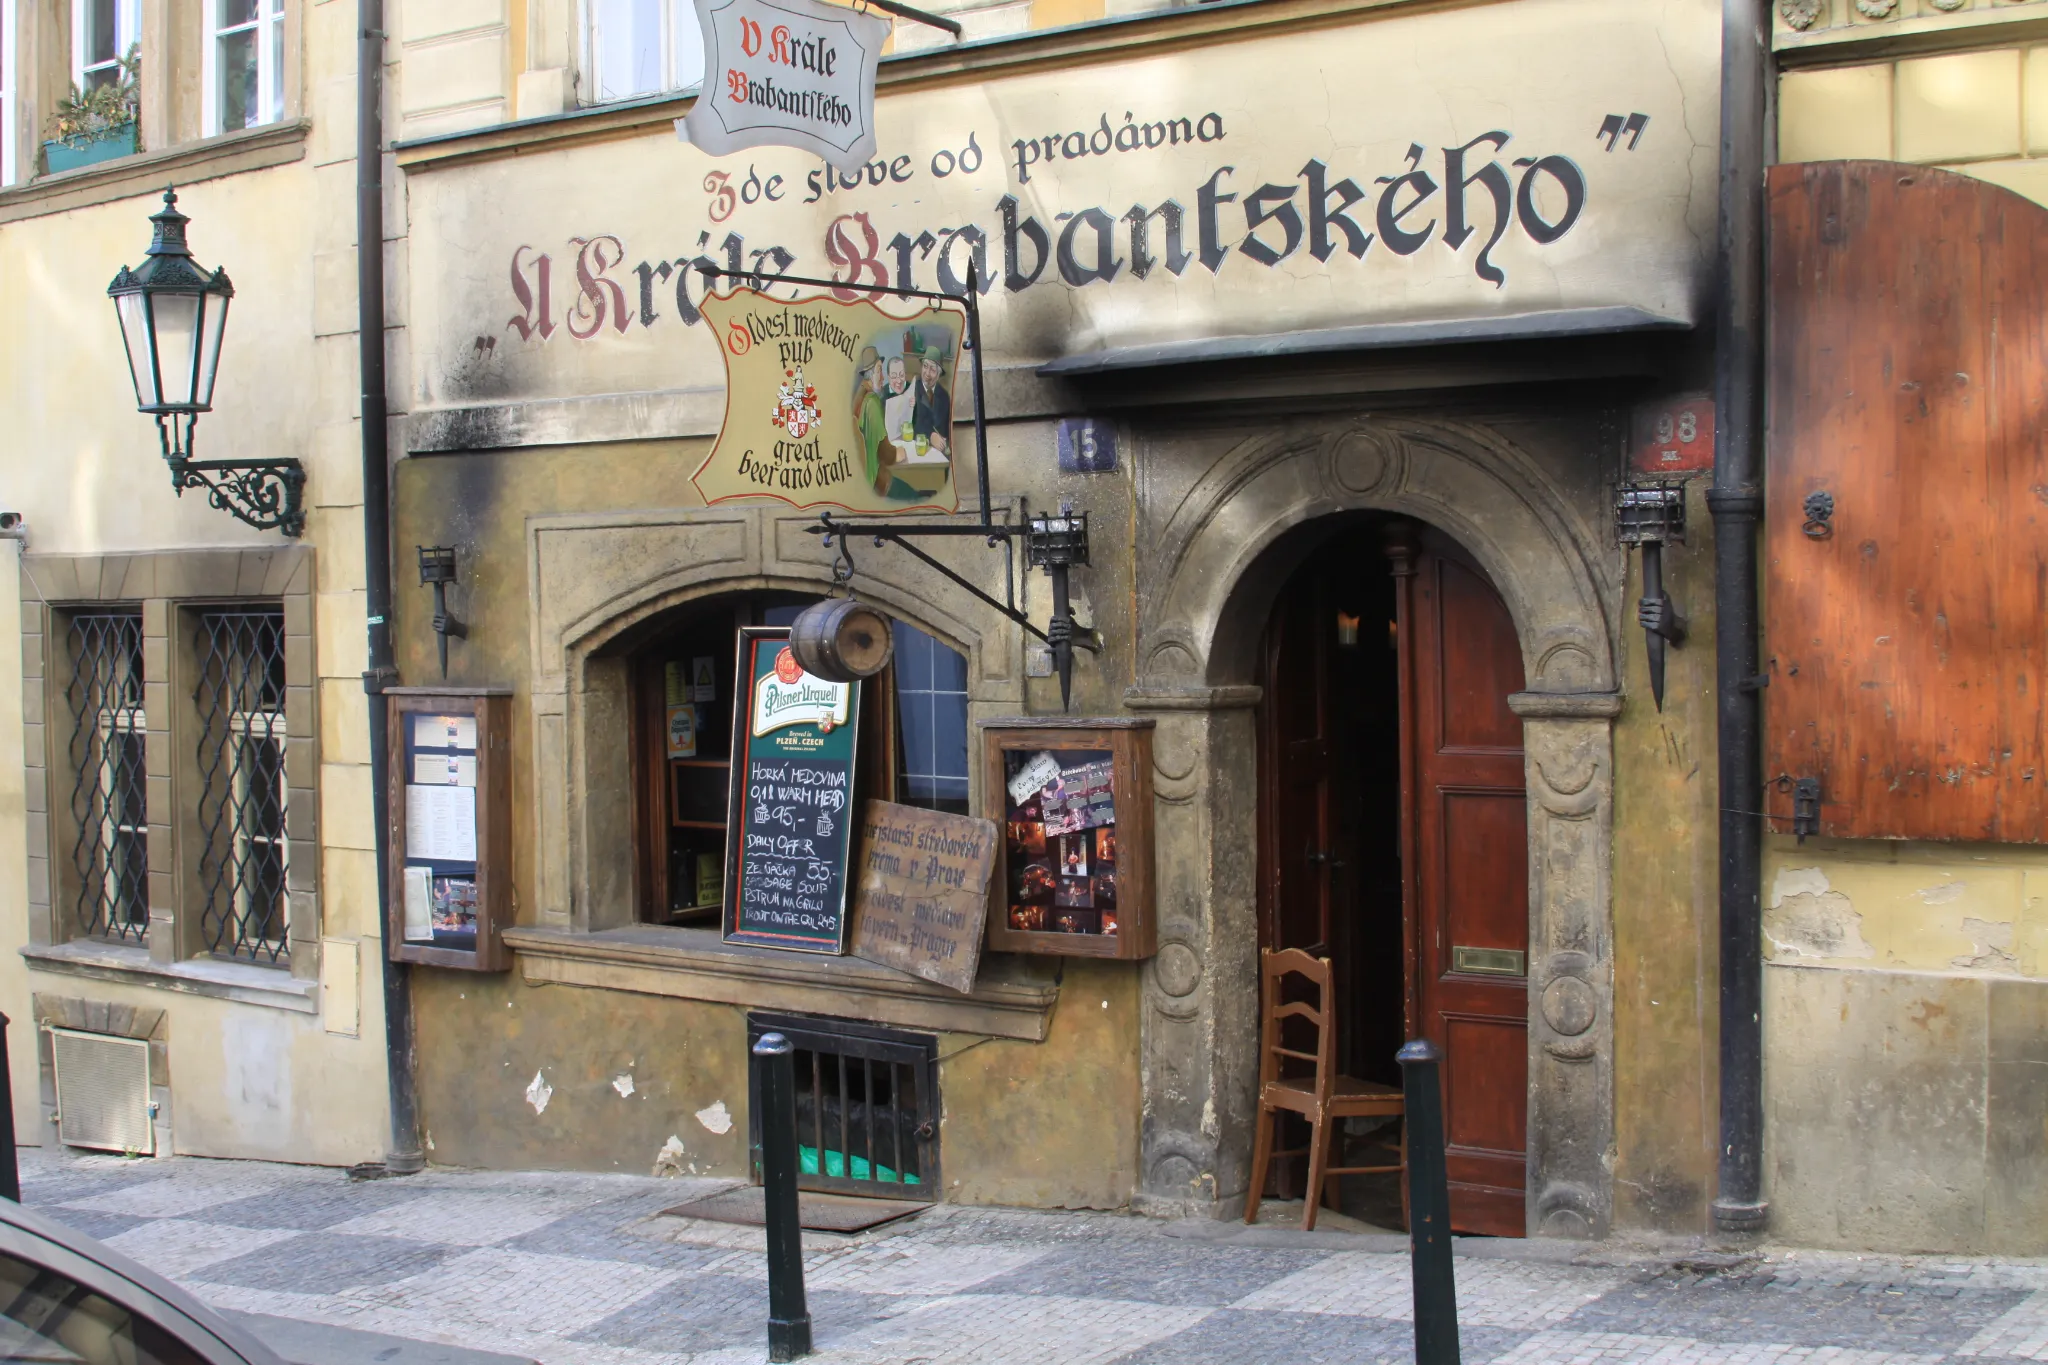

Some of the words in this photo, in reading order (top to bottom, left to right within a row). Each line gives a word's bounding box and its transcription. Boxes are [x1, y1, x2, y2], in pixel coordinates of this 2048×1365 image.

[768, 24, 836, 78] Krále
[802, 154, 914, 204] slove
[931, 131, 983, 178] od
[1011, 111, 1228, 185] pradávna
[728, 307, 791, 356] Oldest
[793, 308, 860, 362] medieval
[779, 338, 813, 370] pub
[774, 434, 823, 466] great
[1070, 427, 1098, 460] 15
[738, 449, 780, 487] beer
[780, 461, 812, 490] and
[816, 449, 852, 487] draft
[764, 683, 803, 717] Pilsner
[802, 683, 838, 709] Urquell
[802, 738, 824, 746] CZECH
[752, 761, 789, 782] HORKÁ
[791, 768, 846, 787] MEDOVINA
[777, 786, 811, 806] WARM
[815, 789, 845, 813] MEAD
[747, 834, 774, 852] DAILY
[744, 887, 779, 906] PSTRUH
[783, 896, 795, 909] NA
[744, 907, 770, 922] TROUT
[771, 911, 783, 924] ON
[783, 911, 800, 925] THE
